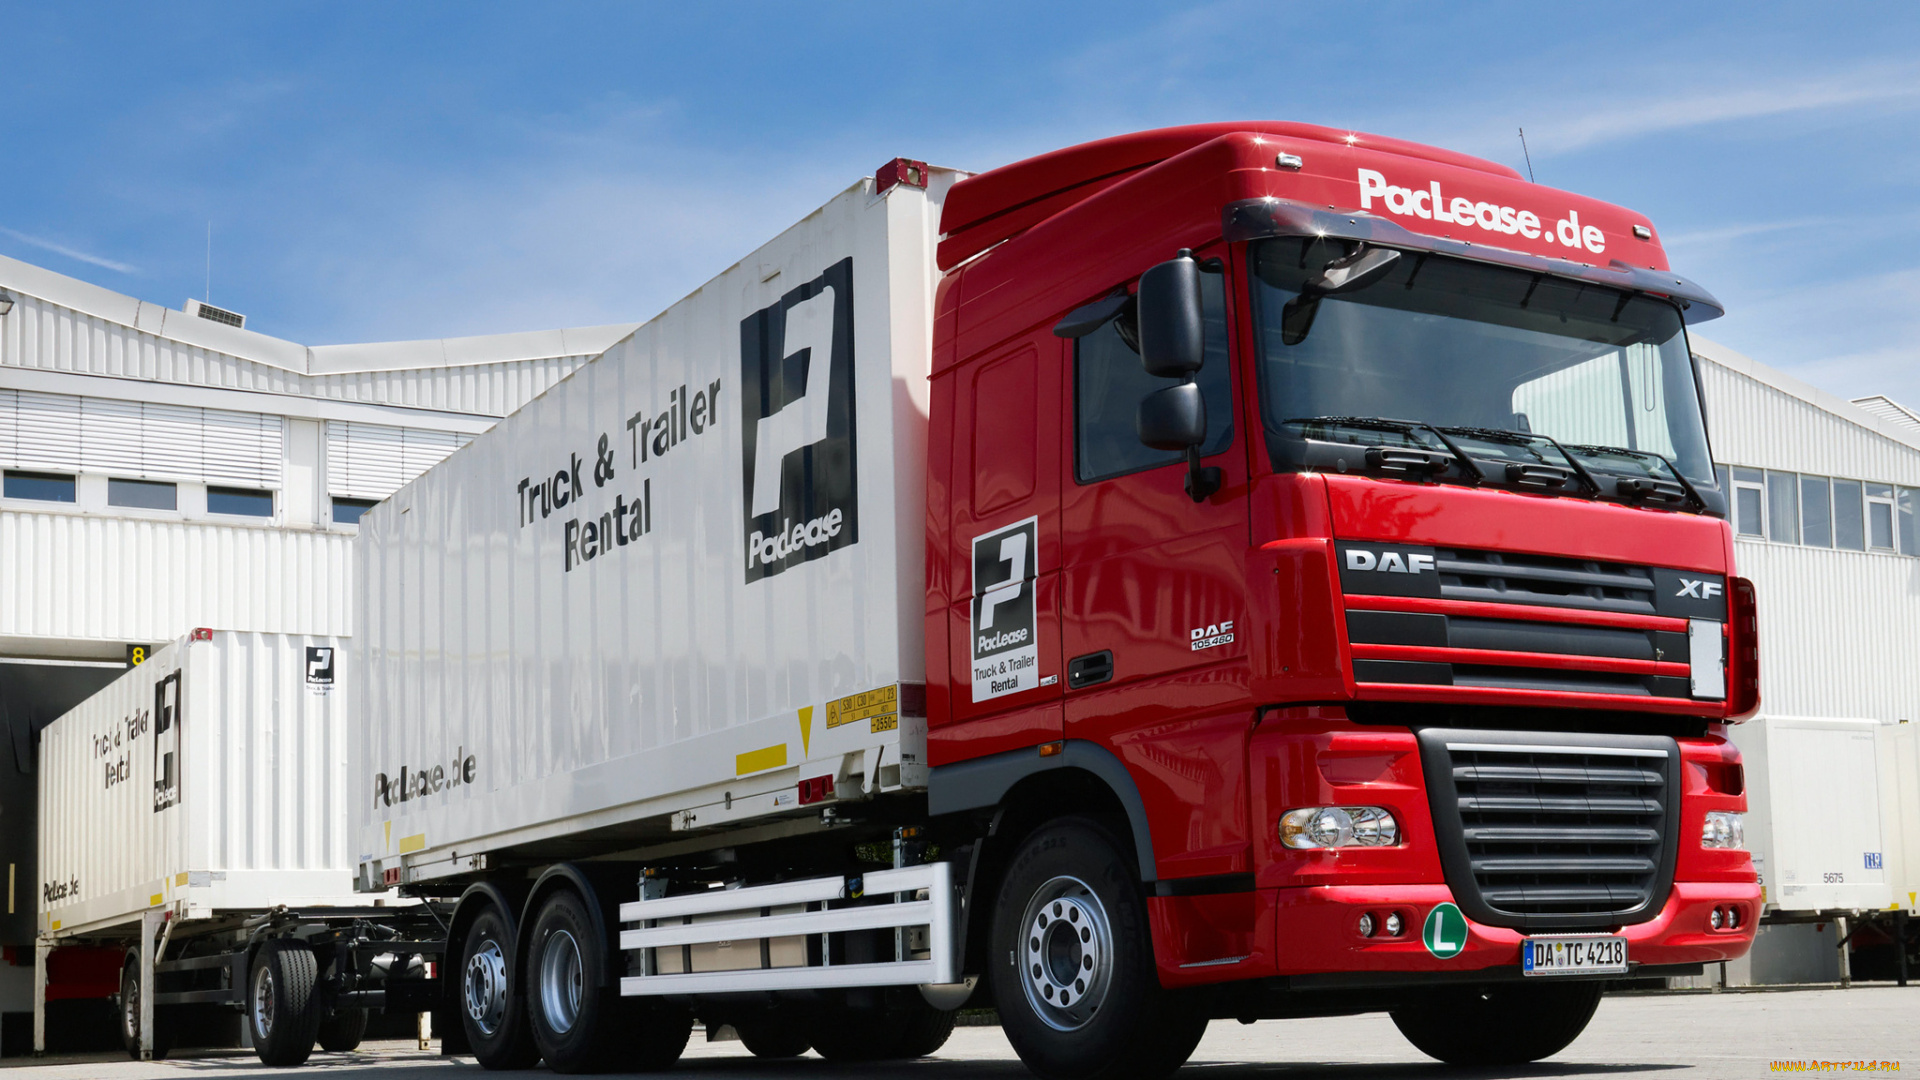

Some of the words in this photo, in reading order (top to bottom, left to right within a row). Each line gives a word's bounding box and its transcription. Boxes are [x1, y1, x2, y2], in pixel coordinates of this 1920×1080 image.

[1358, 168, 1606, 253] PacLease.de
[517, 451, 583, 528] Truck
[594, 432, 614, 488] &
[627, 378, 720, 470] Trailer
[565, 478, 651, 572] Rental
[1345, 549, 1435, 574] DAF
[1676, 578, 1722, 600] XF
[978, 628, 1028, 653] PacLease
[1191, 620, 1234, 640] DAF
[1192, 634, 1233, 650] 105.460
[132, 647, 145, 666] 8
[974, 663, 998, 681] Truck
[999, 661, 1007, 675] &
[1008, 655, 1035, 673] Trailer
[991, 675, 1019, 694] Rental
[1823, 873, 1844, 883] 5675
[1433, 911, 1457, 950] L
[1534, 943, 1554, 966] DA
[1564, 943, 1583, 966] TC
[1587, 941, 1623, 965] 4218
